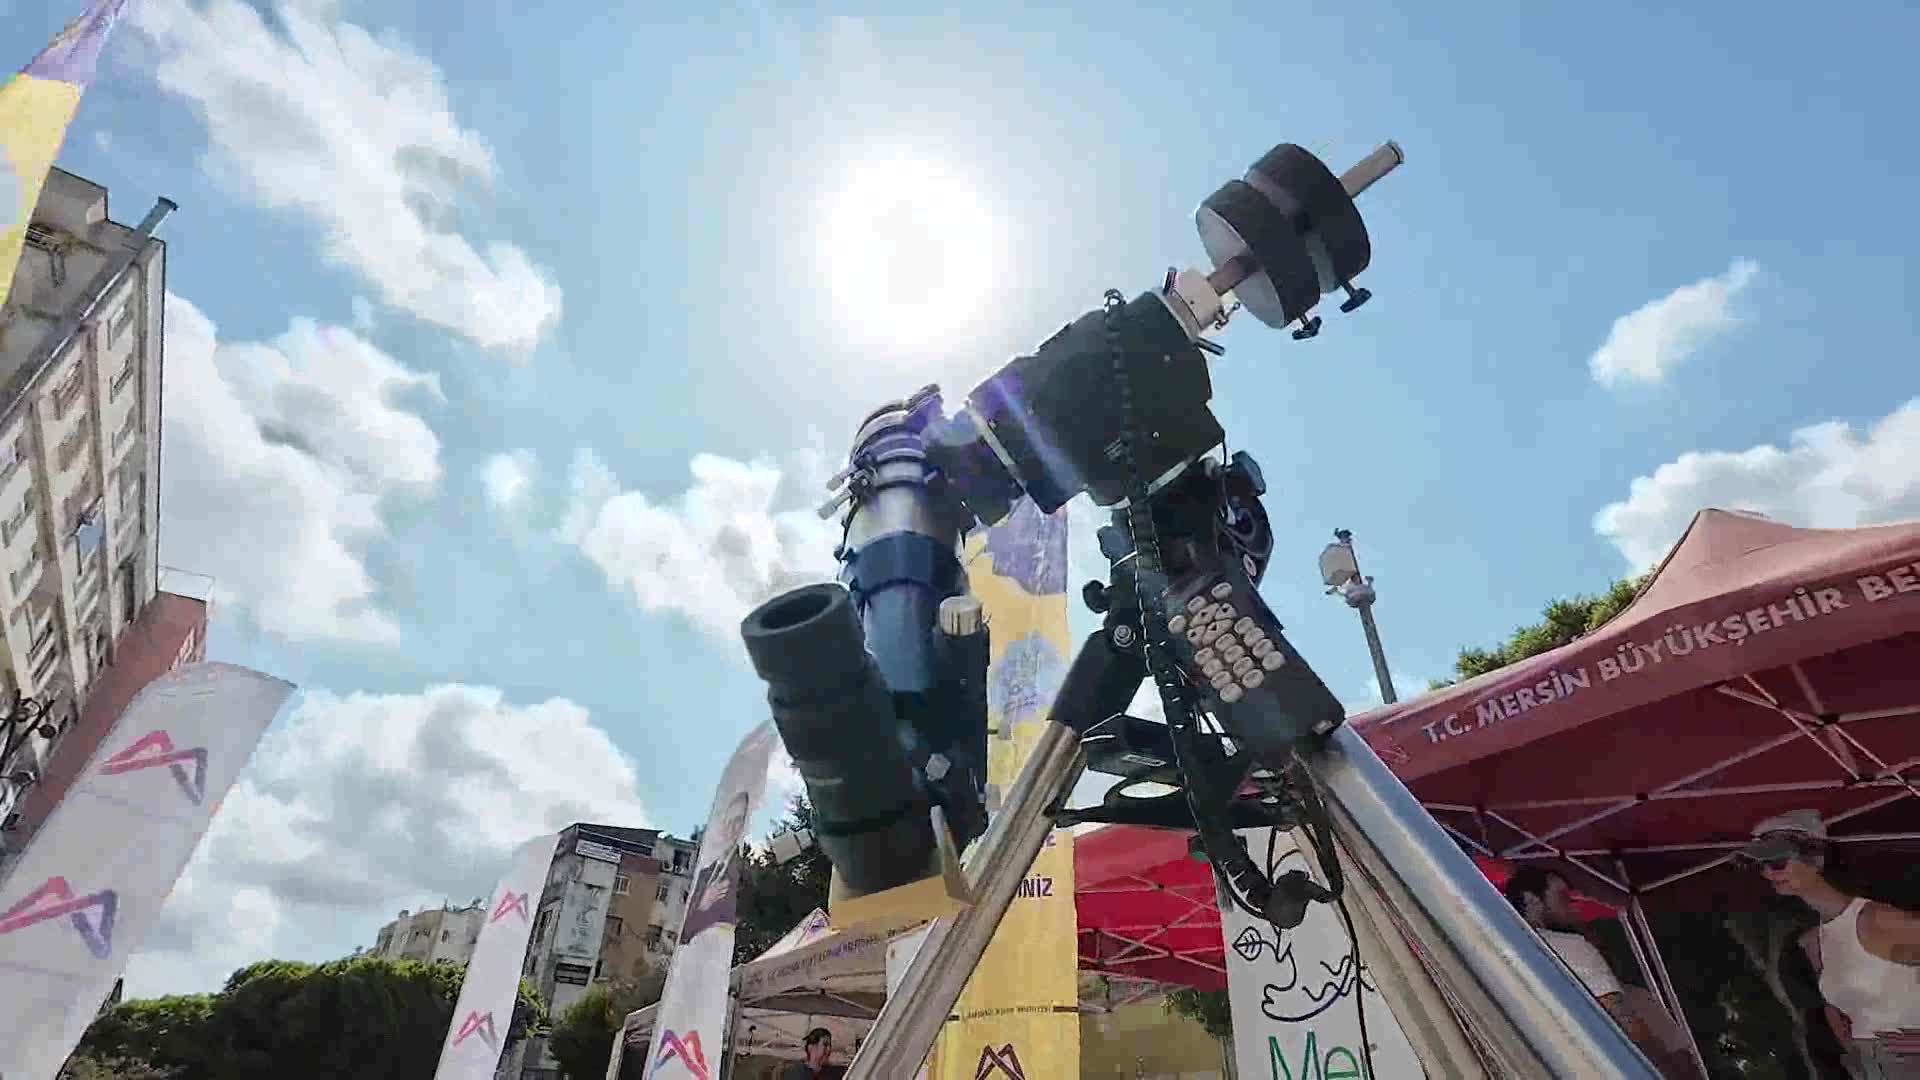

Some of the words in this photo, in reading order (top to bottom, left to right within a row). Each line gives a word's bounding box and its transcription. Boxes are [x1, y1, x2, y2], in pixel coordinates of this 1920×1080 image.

[1421, 713, 1473, 744] T.C.
[1474, 667, 1592, 729] MERSİN
[1597, 586, 1850, 681] BÜYÜKŞEHİR
